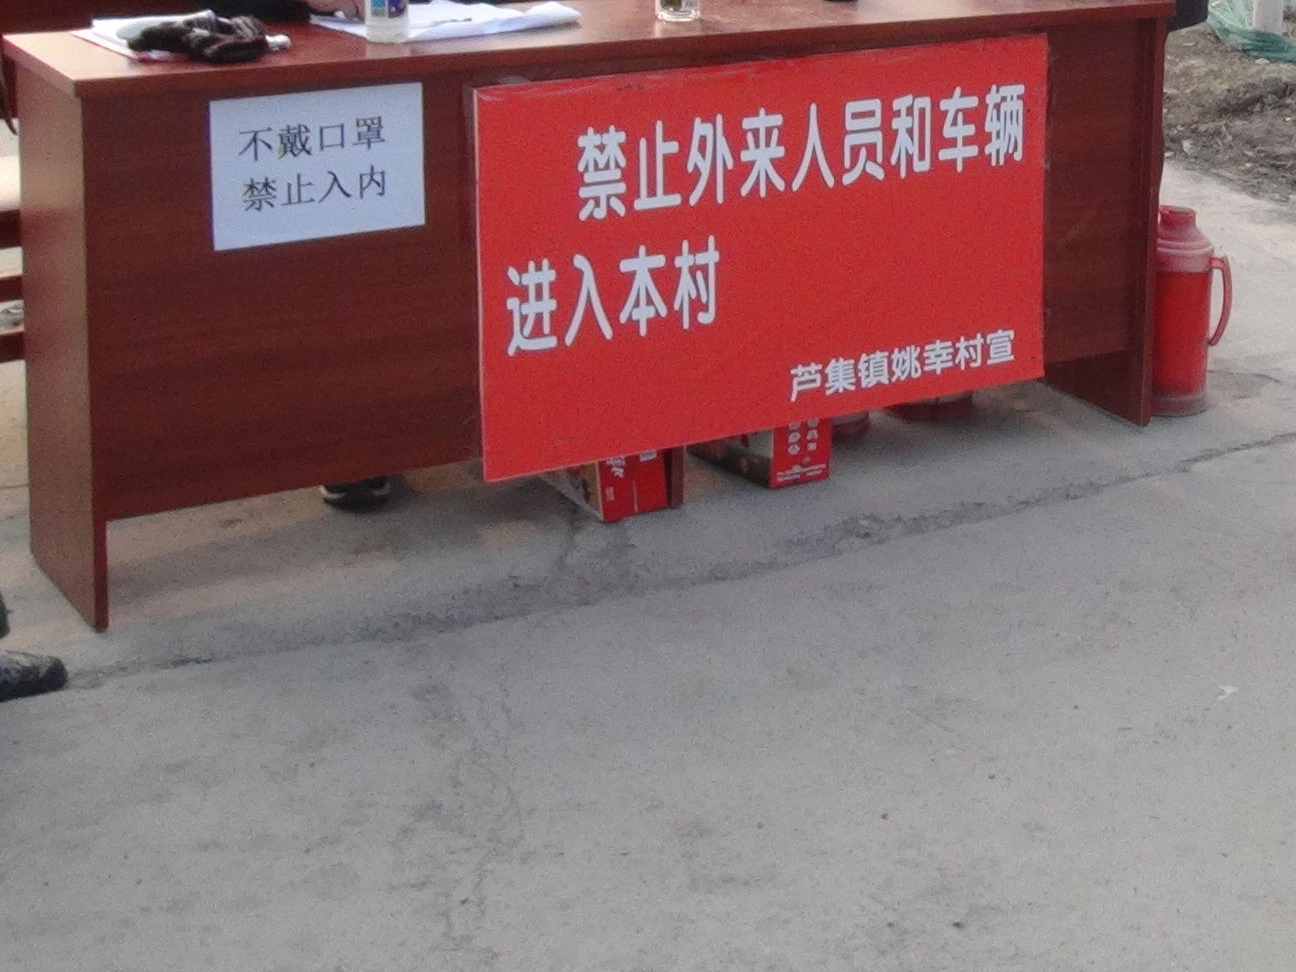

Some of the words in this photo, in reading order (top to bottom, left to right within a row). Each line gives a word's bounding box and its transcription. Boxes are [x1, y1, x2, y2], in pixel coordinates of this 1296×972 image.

[238, 116, 386, 161] 不戴口罩
[576, 83, 1026, 221] 禁止外来人员和车辆
[243, 165, 386, 212] 禁止入内
[506, 234, 721, 357] 进入本村
[789, 328, 1015, 402] 芦集镇姚幸村宣
